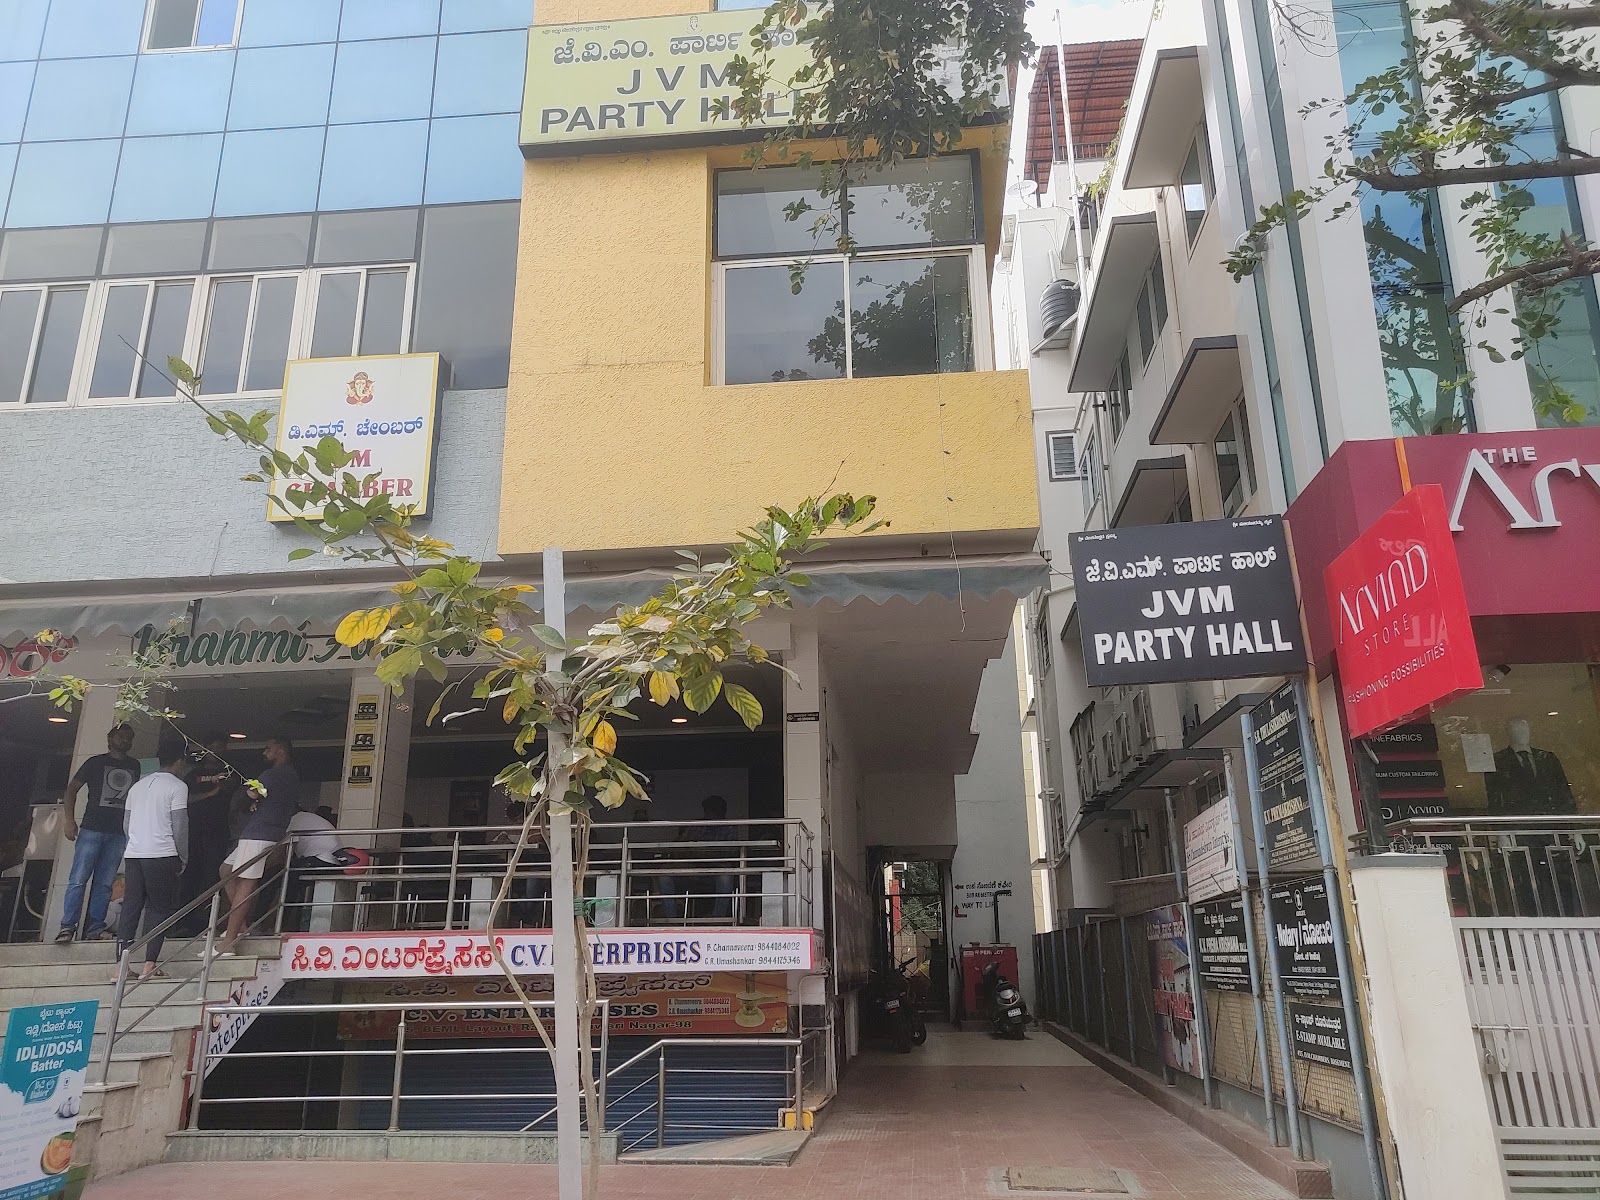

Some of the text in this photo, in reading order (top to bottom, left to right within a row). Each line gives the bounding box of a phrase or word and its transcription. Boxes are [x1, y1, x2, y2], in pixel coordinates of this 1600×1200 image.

[541, 99, 687, 134] PARTY
[1482, 446, 1538, 464] THE
[1141, 585, 1235, 618] JVM
[1094, 619, 1293, 665] PARTY HALL
[1364, 612, 1410, 656] STORE
[1390, 643, 1446, 682] POSSIBILITIES
[1276, 923, 1299, 952] Notary
[629, 1020, 692, 1033] Nagar-98
[1295, 1030, 1347, 1050] E-STAMP AVAILABLE
[15, 1038, 84, 1063] IDLI/DOSA
[30, 1059, 65, 1074] Batter
